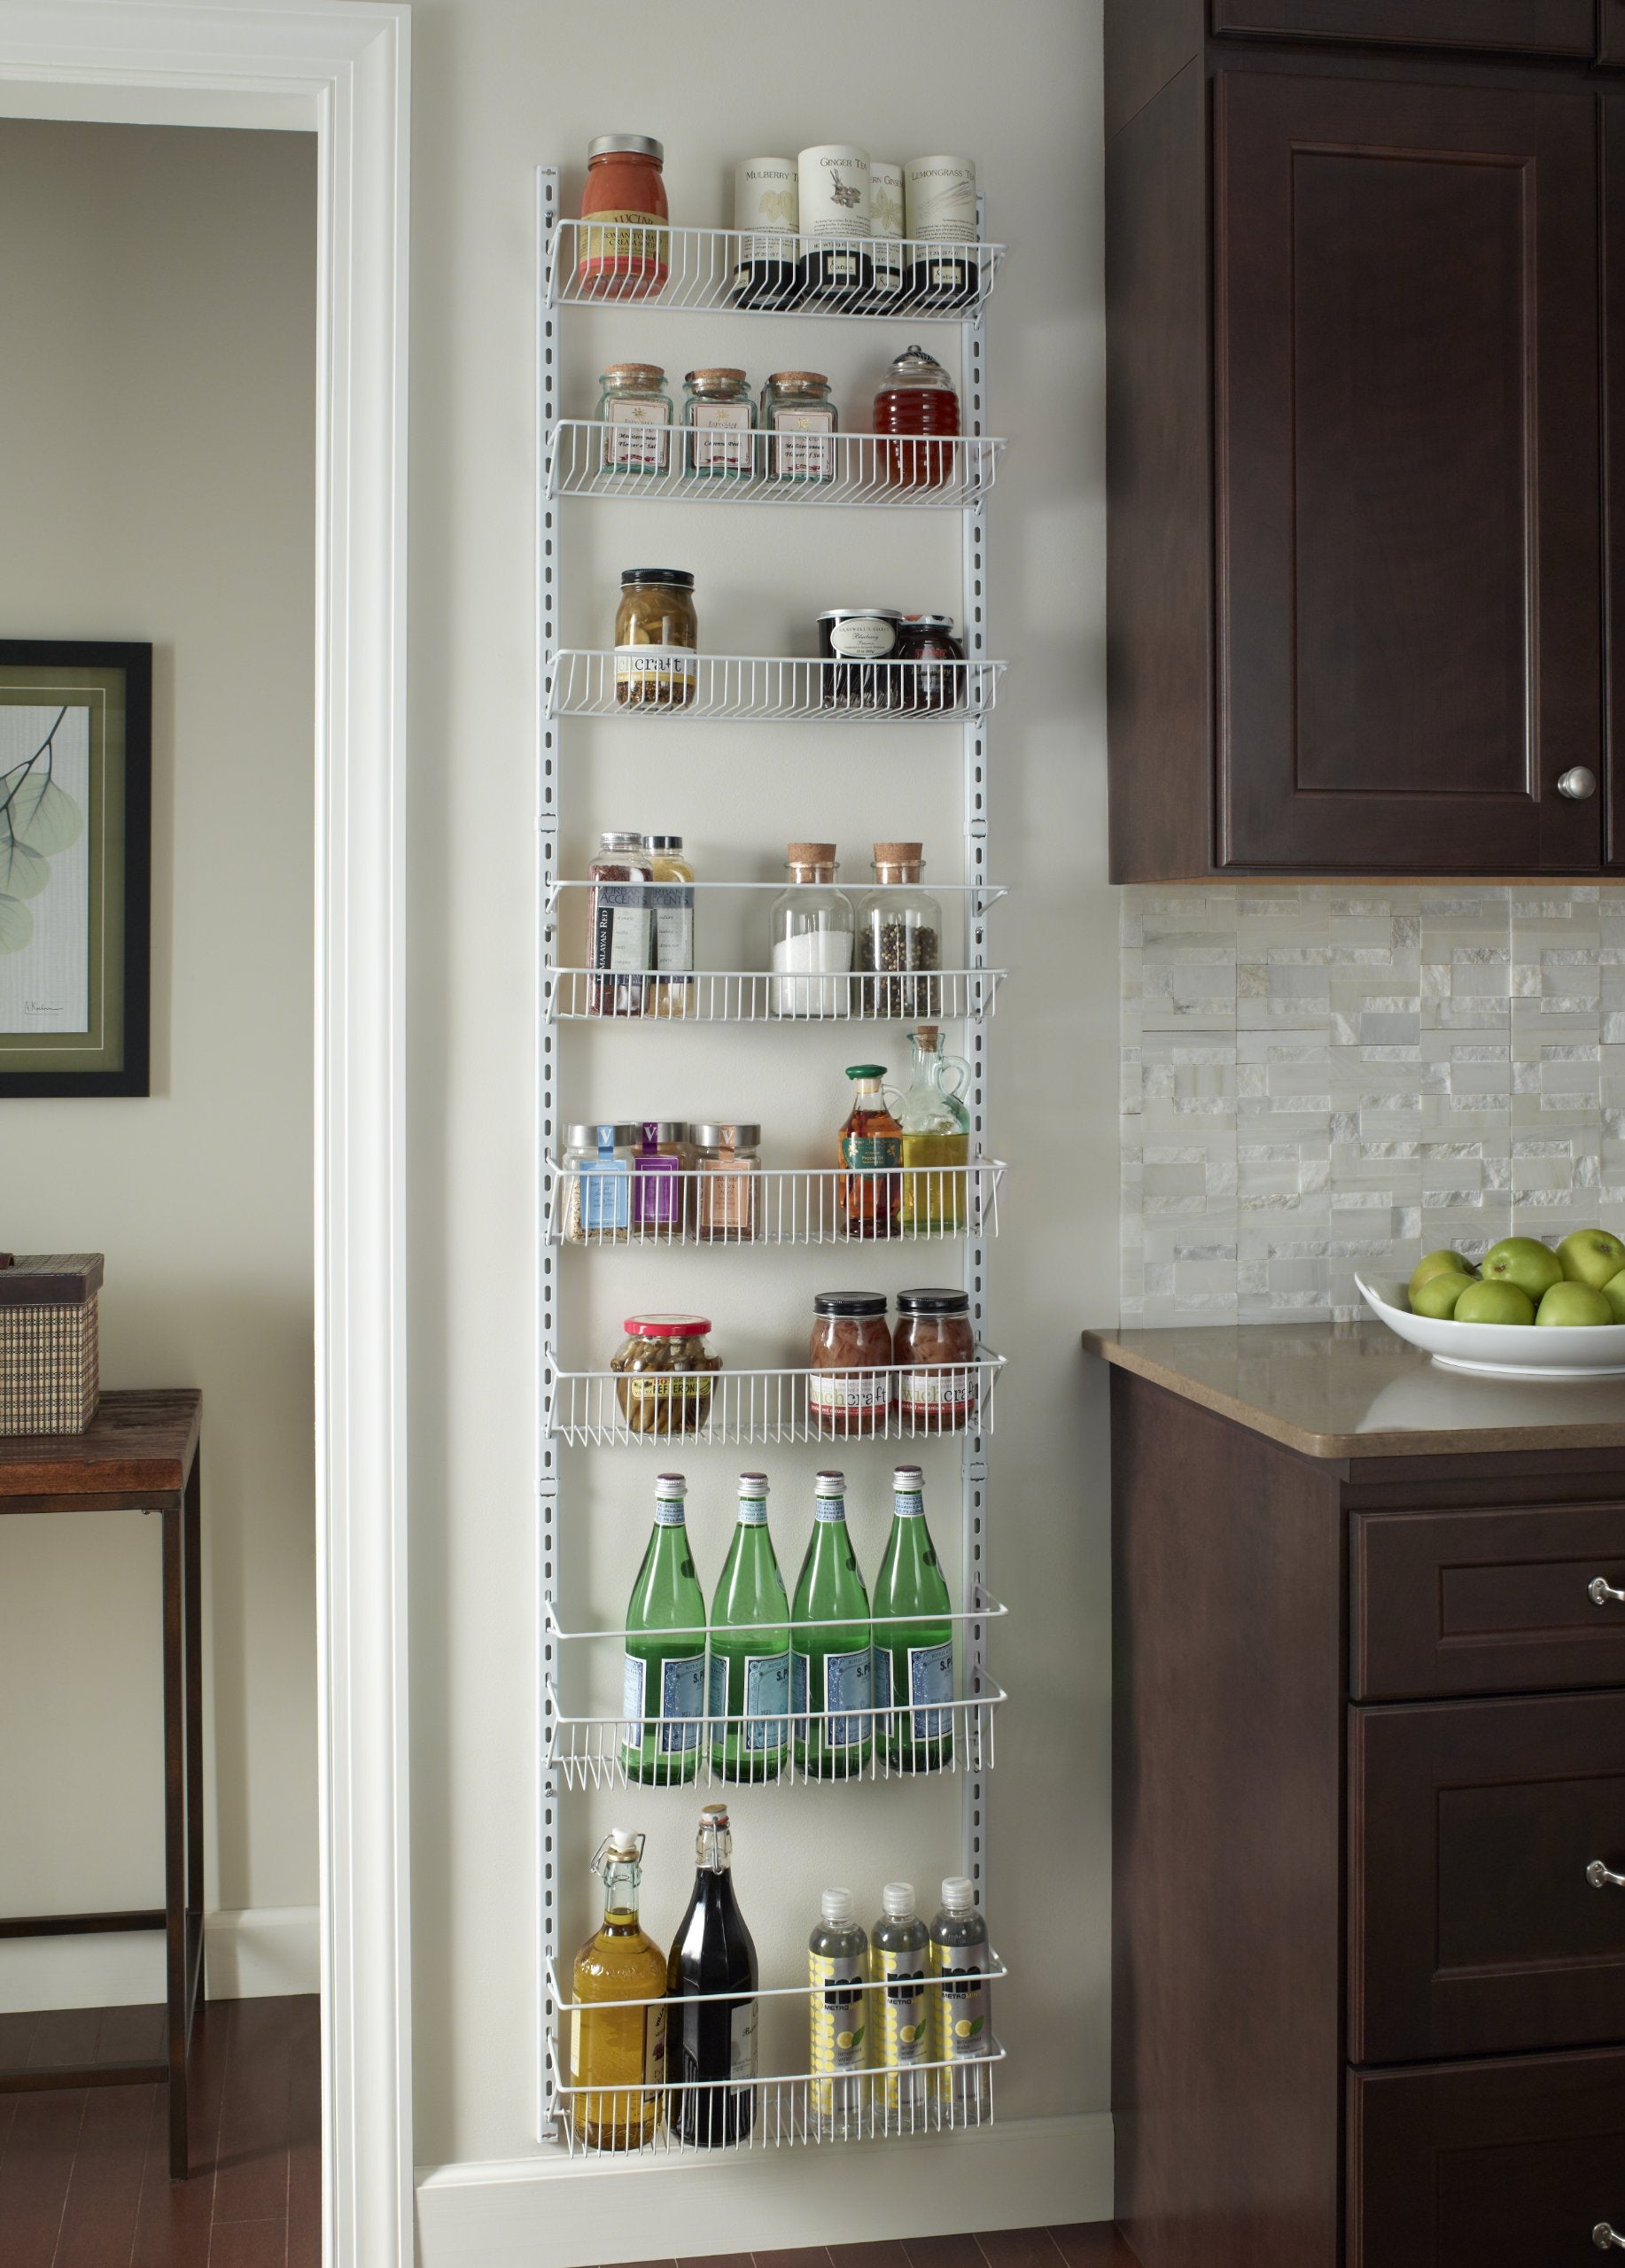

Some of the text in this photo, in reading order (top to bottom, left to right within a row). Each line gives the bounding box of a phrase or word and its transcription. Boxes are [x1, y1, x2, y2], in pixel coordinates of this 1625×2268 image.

[820, 157, 852, 167] GINGER
[746, 170, 789, 181] MULBERRY
[912, 169, 963, 182] LEMONGRASS
[599, 910, 608, 928] RED
[600, 1129, 612, 1145] V
[643, 1126, 657, 1142] V
[721, 1130, 735, 1145] V
